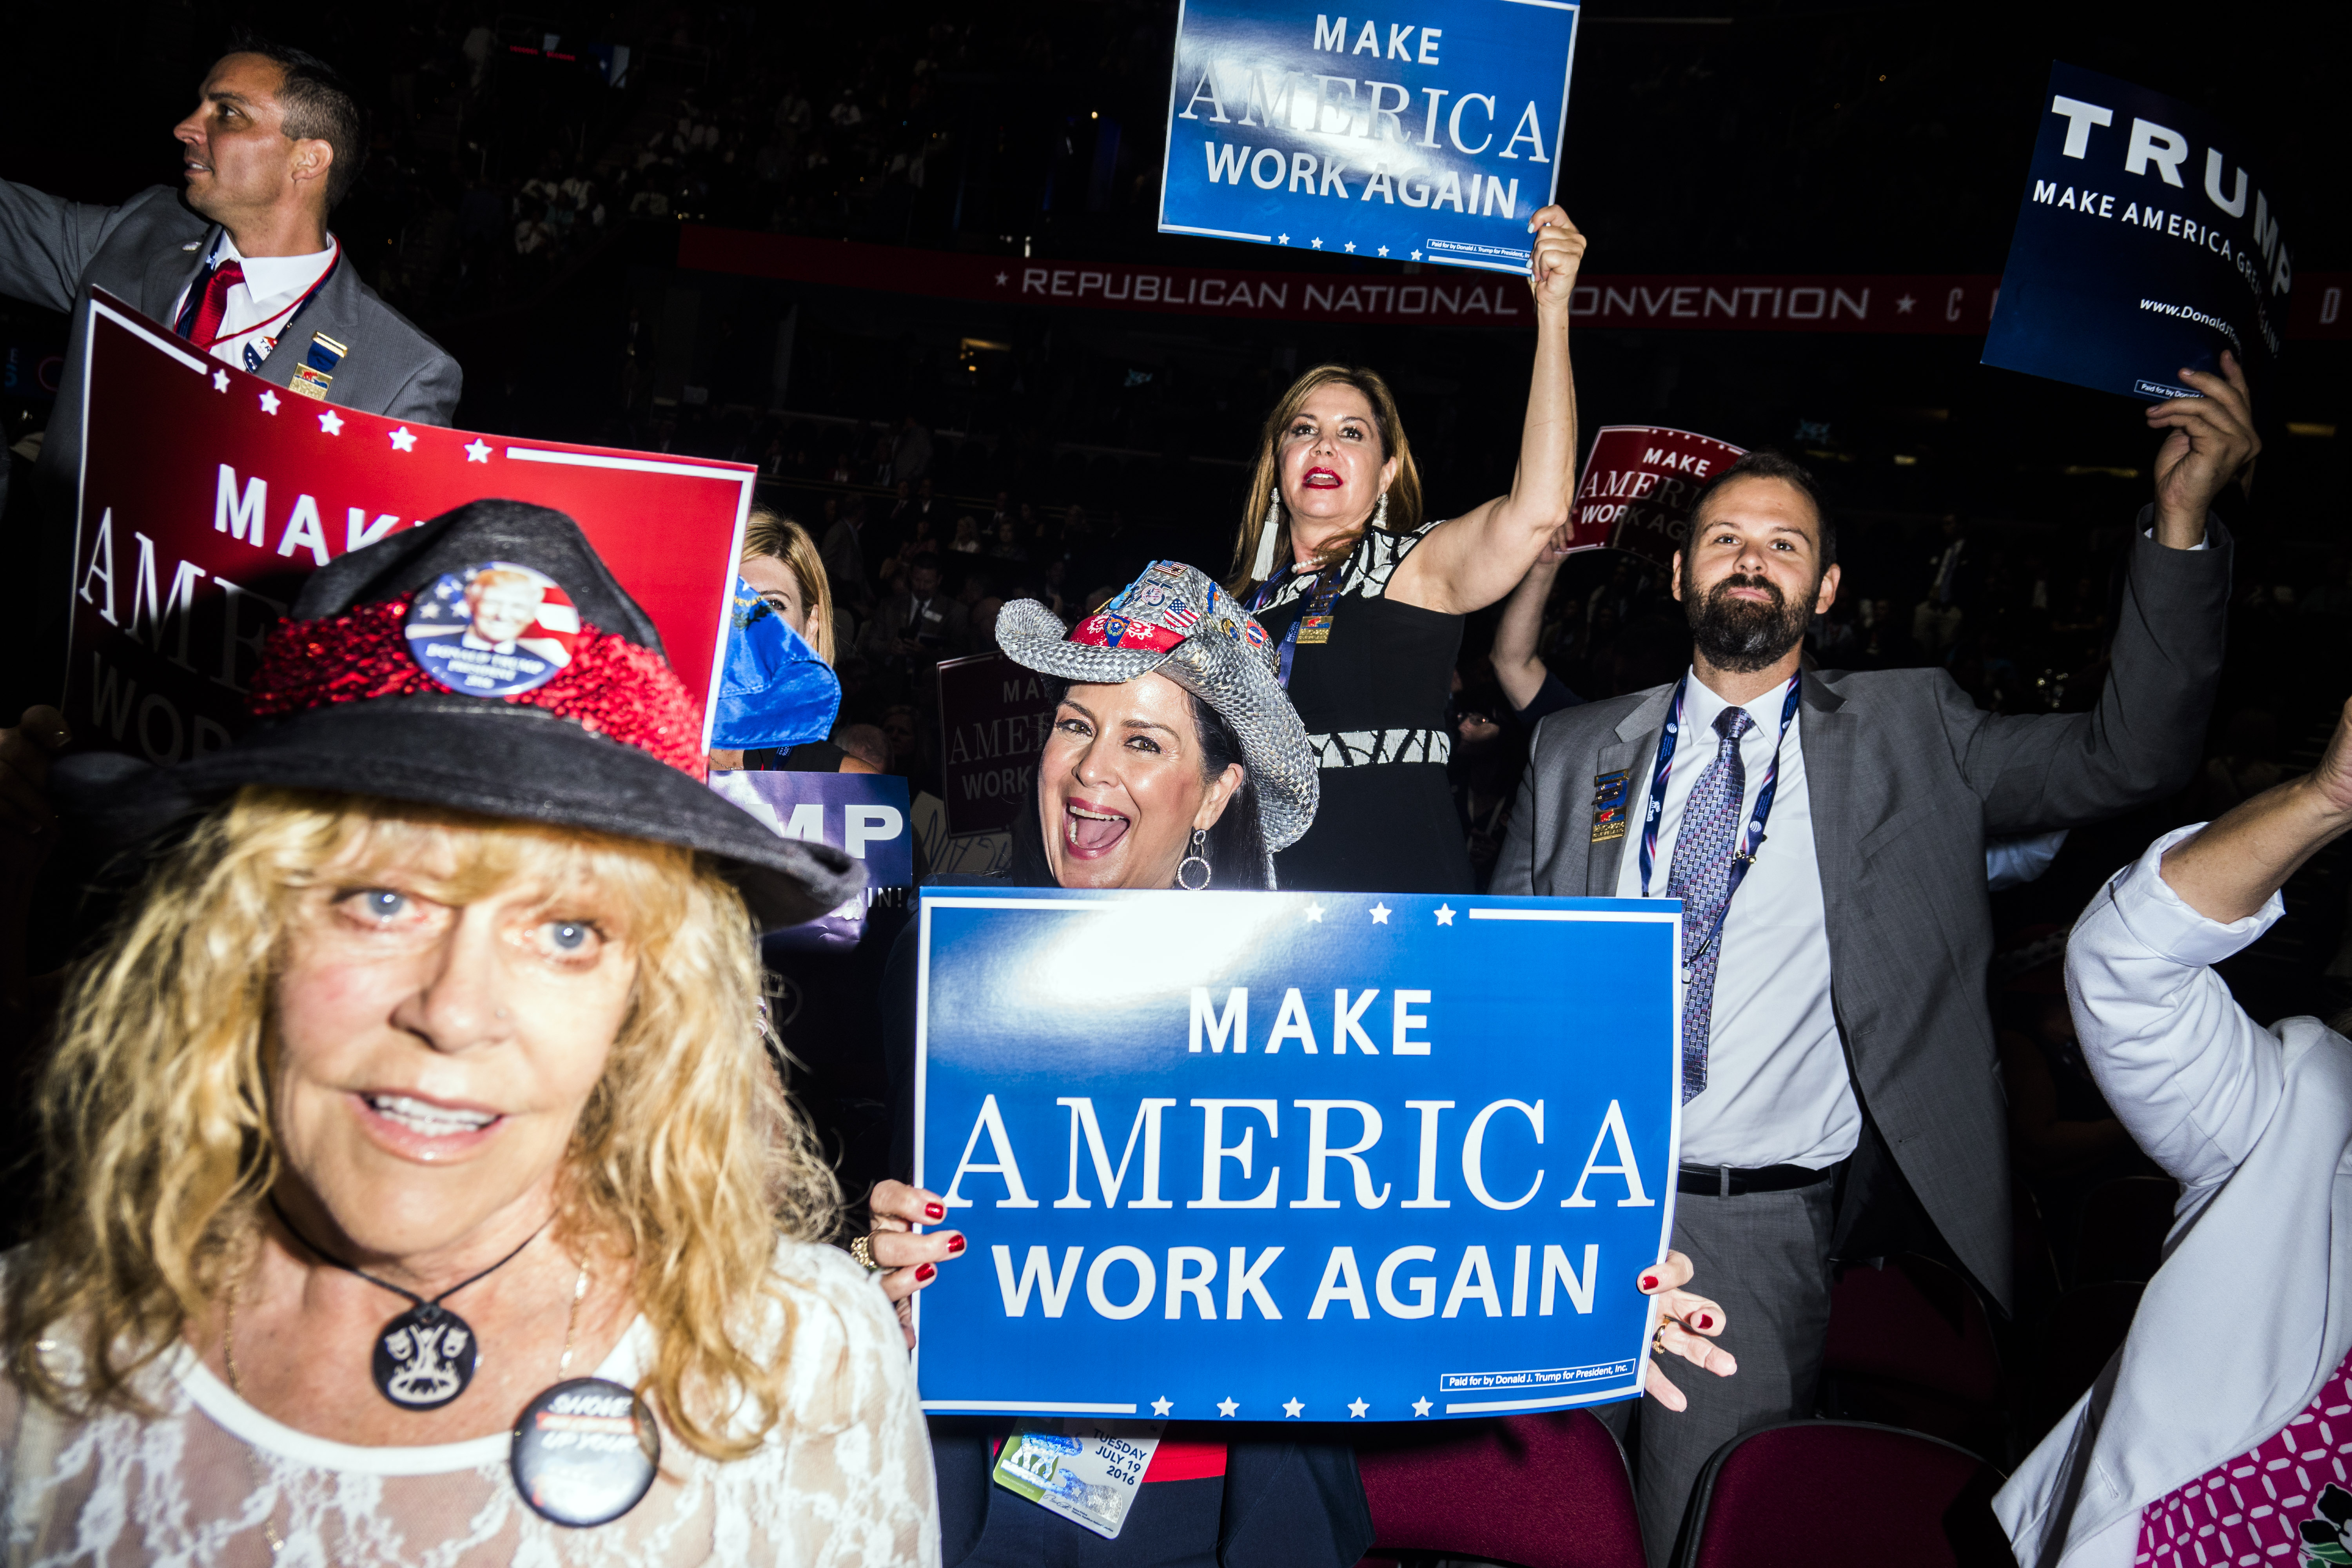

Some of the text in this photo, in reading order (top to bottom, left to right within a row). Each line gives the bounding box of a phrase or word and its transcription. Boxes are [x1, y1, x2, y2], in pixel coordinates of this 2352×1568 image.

[1313, 14, 1443, 66] MAKE
[1178, 59, 1550, 163] AMERICA
[1205, 140, 1519, 219] WORK AGAIN
[2051, 94, 2292, 298] TRUMP
[2033, 179, 2116, 219] MAKE
[2121, 202, 2232, 262] AMERICA
[1501, 249, 1524, 258] President,
[1021, 267, 1289, 309] REPUBLICAN
[1302, 283, 1518, 315] NATIONAL
[1568, 286, 1871, 320] ONVENTION
[2141, 383, 2156, 392] Paid
[2156, 386, 2165, 394] for
[2165, 388, 2174, 397] by
[1642, 446, 1712, 478] MAKE
[1579, 470, 1704, 513] AMER
[214, 463, 425, 567] MAK
[1581, 503, 1646, 526] WORK
[1003, 677, 1048, 703] MA
[962, 765, 1032, 800] WORK
[1188, 986, 1432, 1056] MAKE
[942, 1093, 1656, 1211] AMERICA
[990, 1243, 1600, 1321] WORK AGAIN
[1449, 1364, 1628, 1387] Paid for by Donald J. Trump for President, Inc.
[1094, 1428, 1147, 1461] TUESDAY
[1095, 1446, 1141, 1473] JULY 19
[1001, 1474, 1035, 1494] www.convention.gop
[1106, 1465, 1135, 1485] 2016
